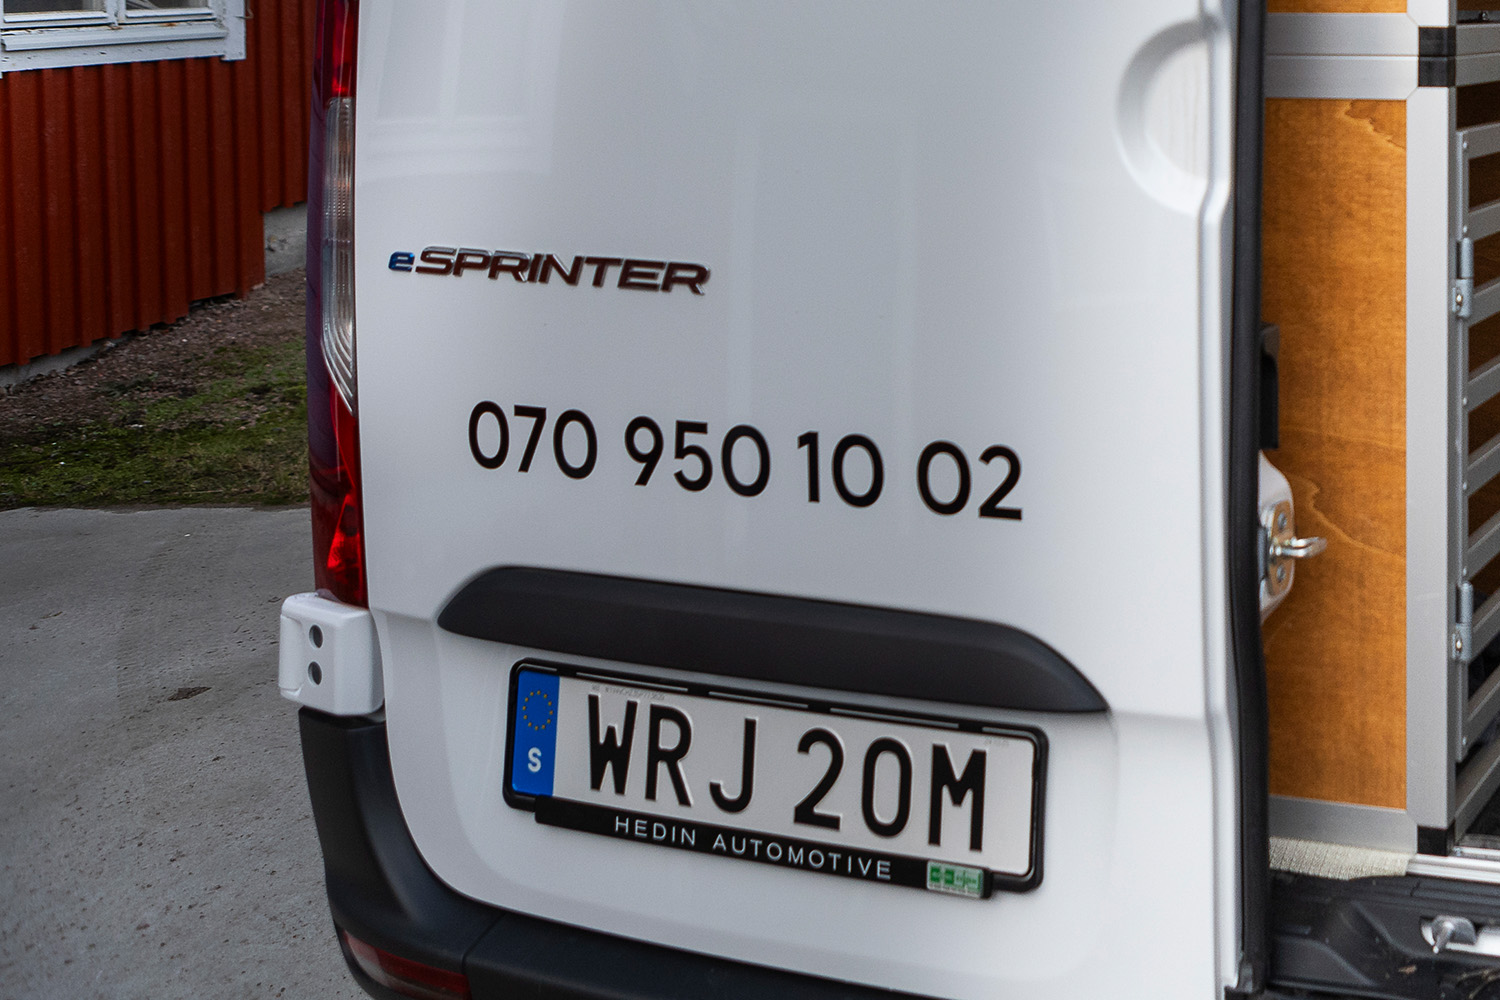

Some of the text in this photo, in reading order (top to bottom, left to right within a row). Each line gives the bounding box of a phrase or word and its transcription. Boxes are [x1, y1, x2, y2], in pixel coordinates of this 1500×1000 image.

[388, 246, 711, 296] eSPRINTER
[468, 400, 1023, 521] 070 950 10 02
[527, 747, 543, 773] S
[587, 693, 987, 853] WRJ 20M
[614, 814, 697, 847] HEDIN
[711, 833, 893, 881] AUTOMOTIVE
